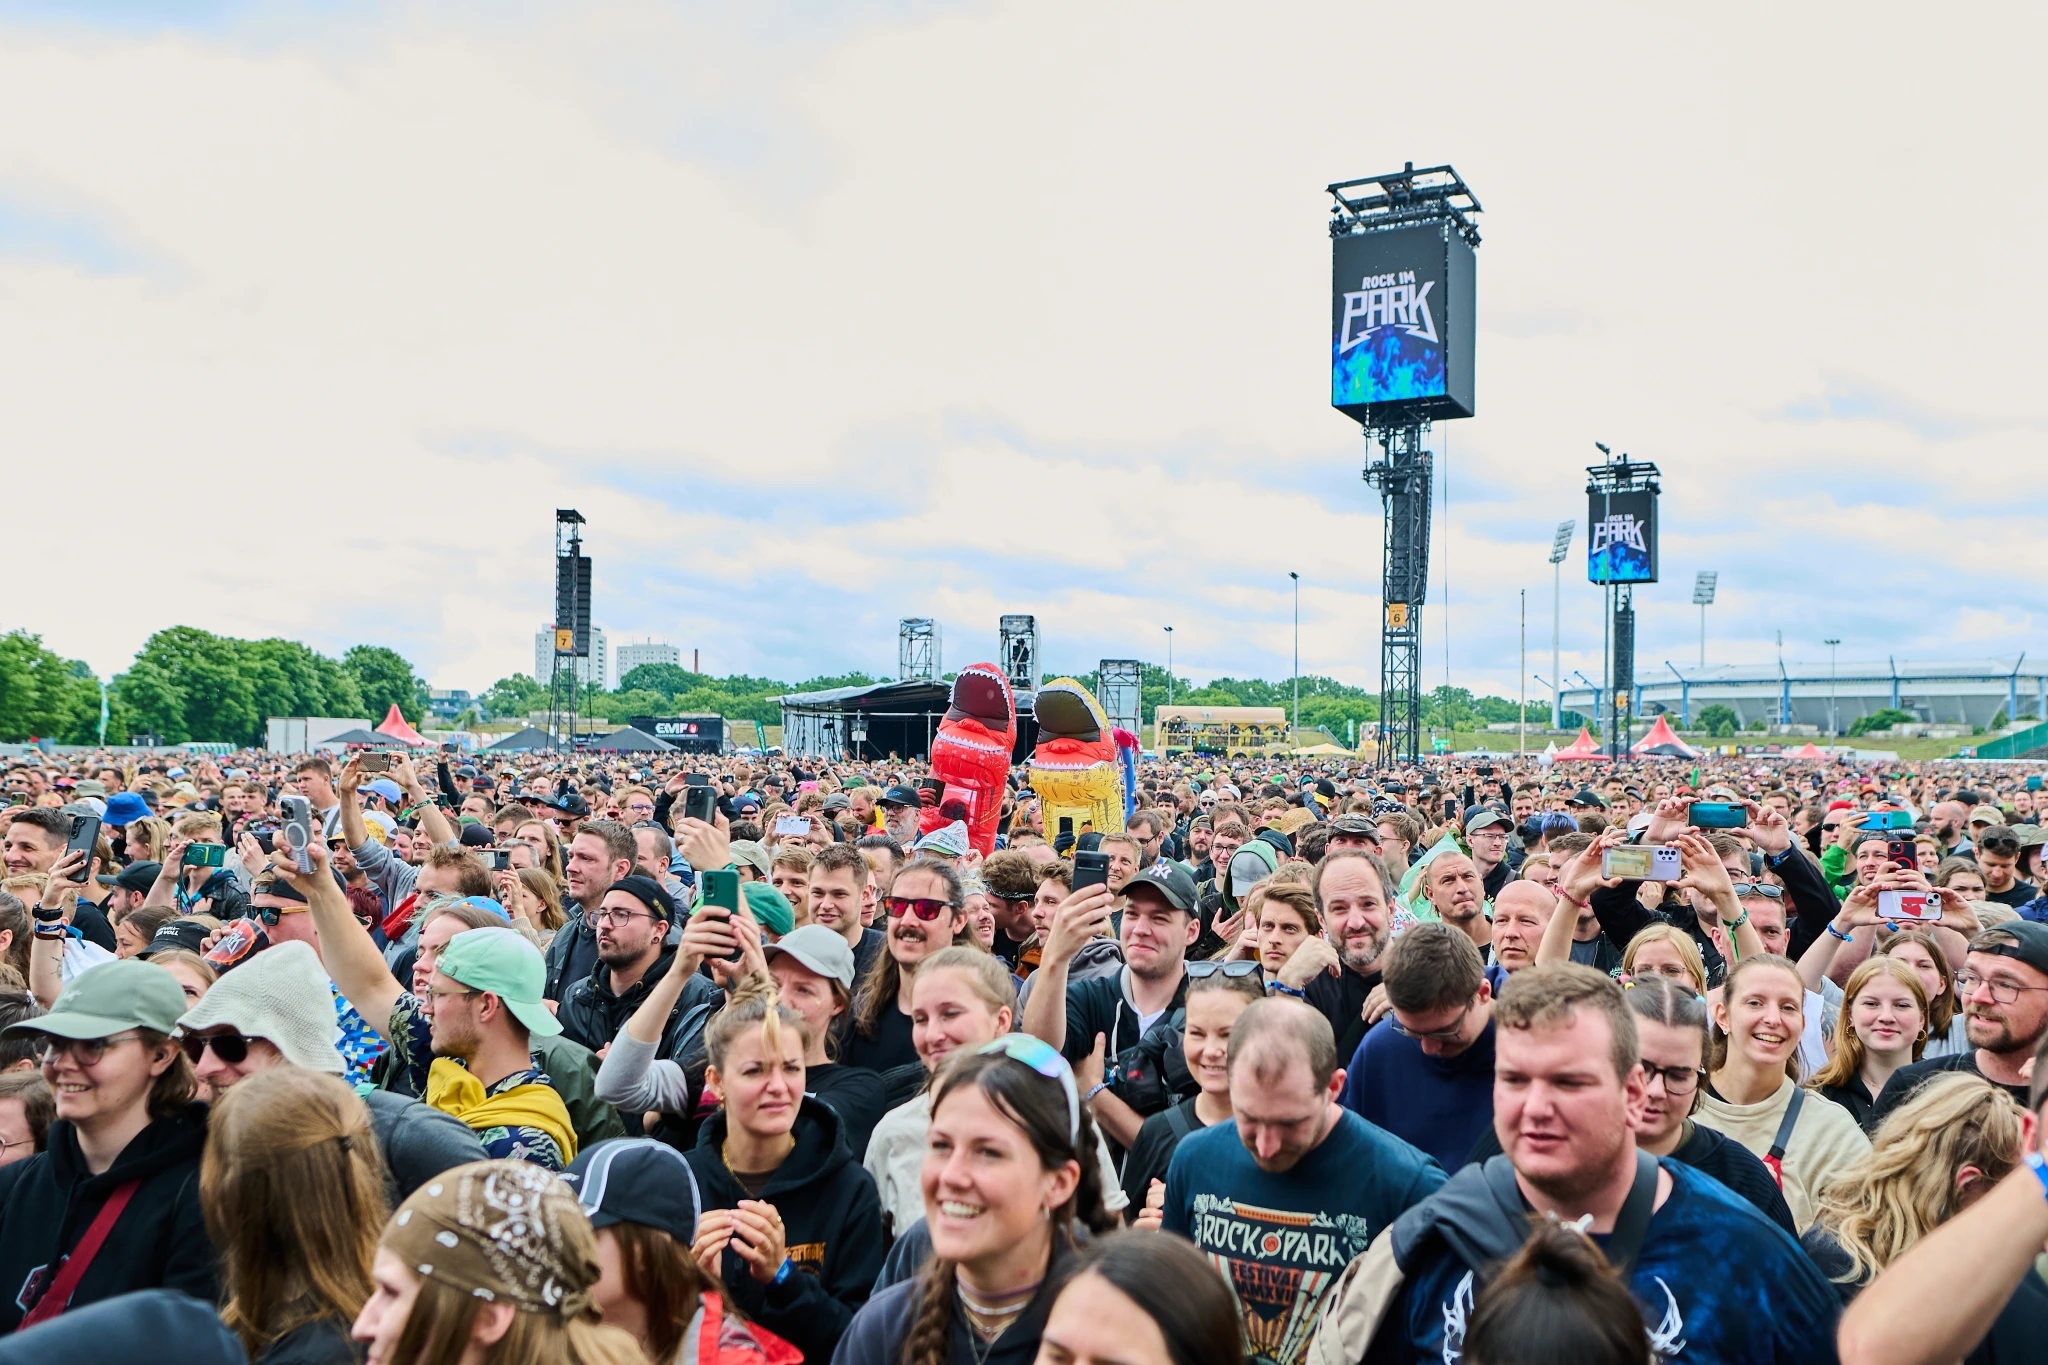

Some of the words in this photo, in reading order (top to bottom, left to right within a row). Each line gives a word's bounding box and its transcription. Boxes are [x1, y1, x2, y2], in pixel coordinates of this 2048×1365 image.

[1362, 273, 1396, 290] ROCK
[1399, 270, 1416, 285] IM
[1340, 281, 1439, 354] PARK
[1592, 520, 1647, 554] PARK
[1393, 613, 1401, 623] 6
[561, 638, 567, 646] 7
[655, 722, 688, 734] EMP
[1202, 1214, 1262, 1256] ROCK
[1281, 1230, 1347, 1267] PARK
[1230, 1261, 1300, 1287] FESTIVAL
